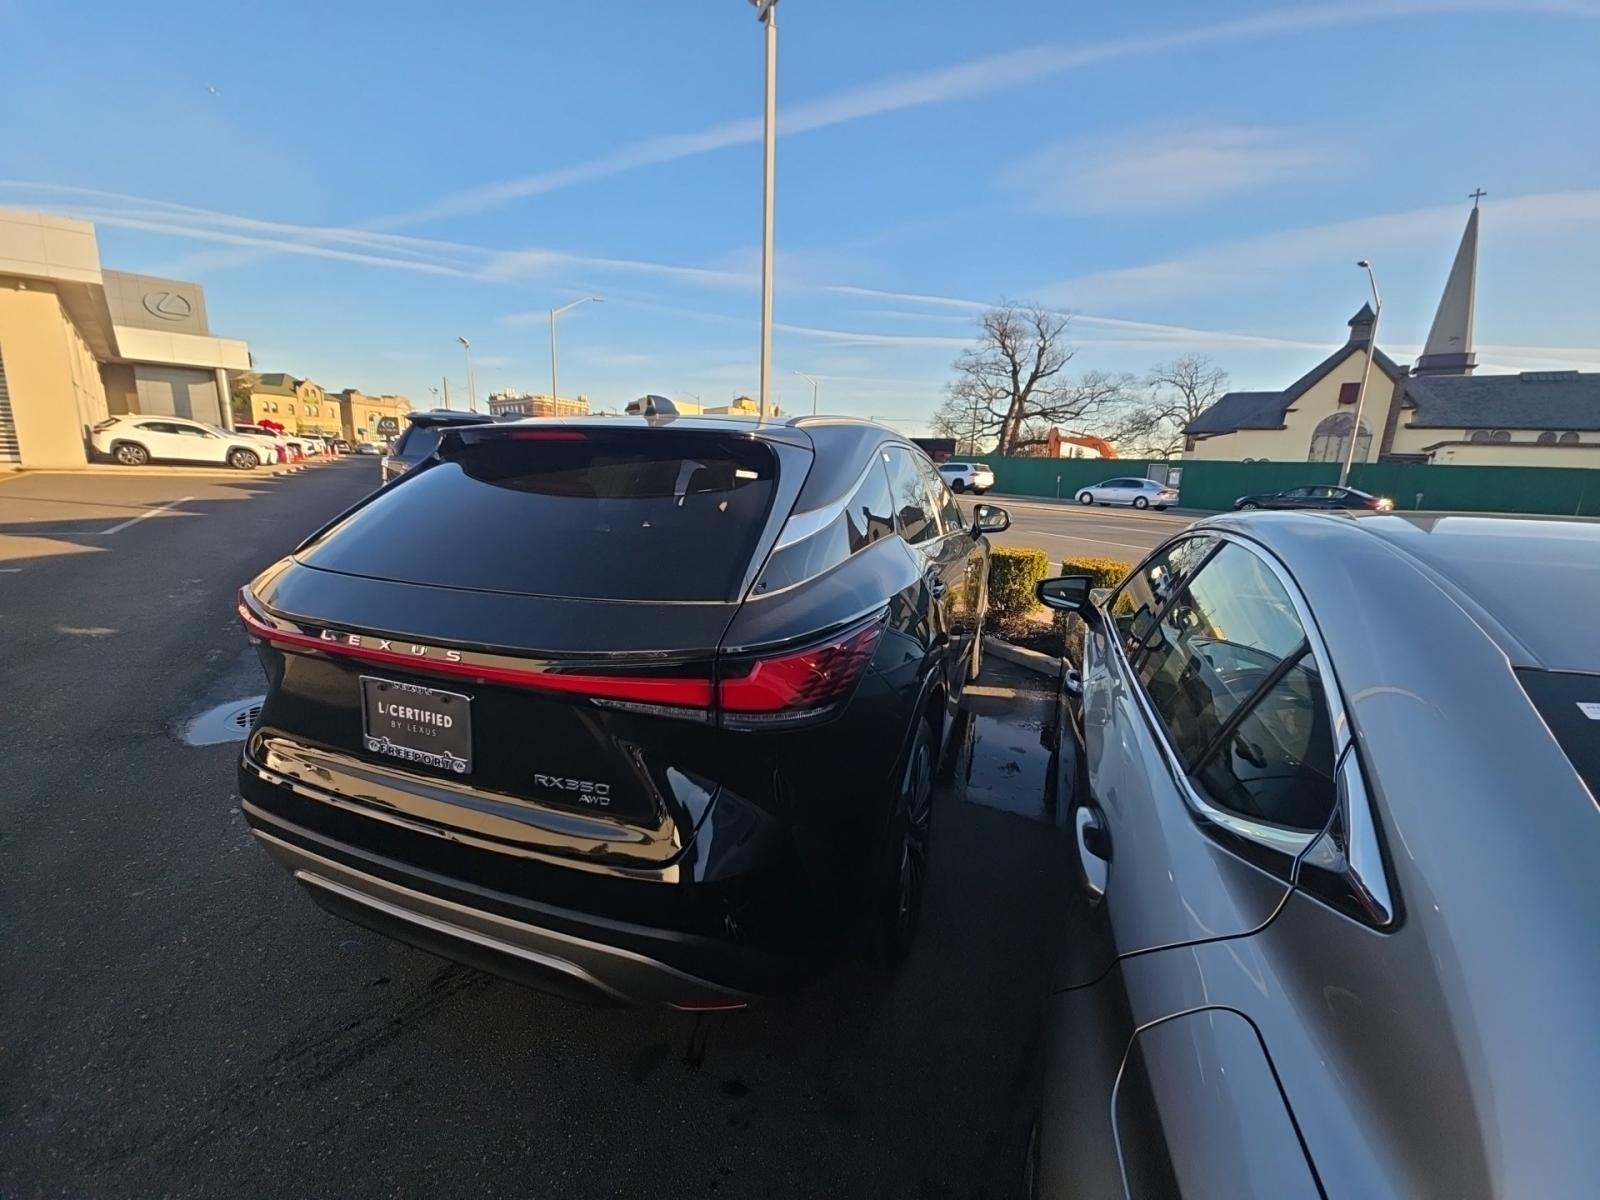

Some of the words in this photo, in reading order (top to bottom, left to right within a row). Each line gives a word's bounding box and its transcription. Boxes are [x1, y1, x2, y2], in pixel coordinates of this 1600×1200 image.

[320, 629, 461, 662] LEXUS
[378, 700, 453, 728] L/CERTIFIED
[391, 720, 402, 729] BY
[407, 724, 437, 737] LEXUS
[380, 744, 452, 769] FREEPORT
[534, 773, 610, 795] RX350
[579, 794, 610, 806] AWD
